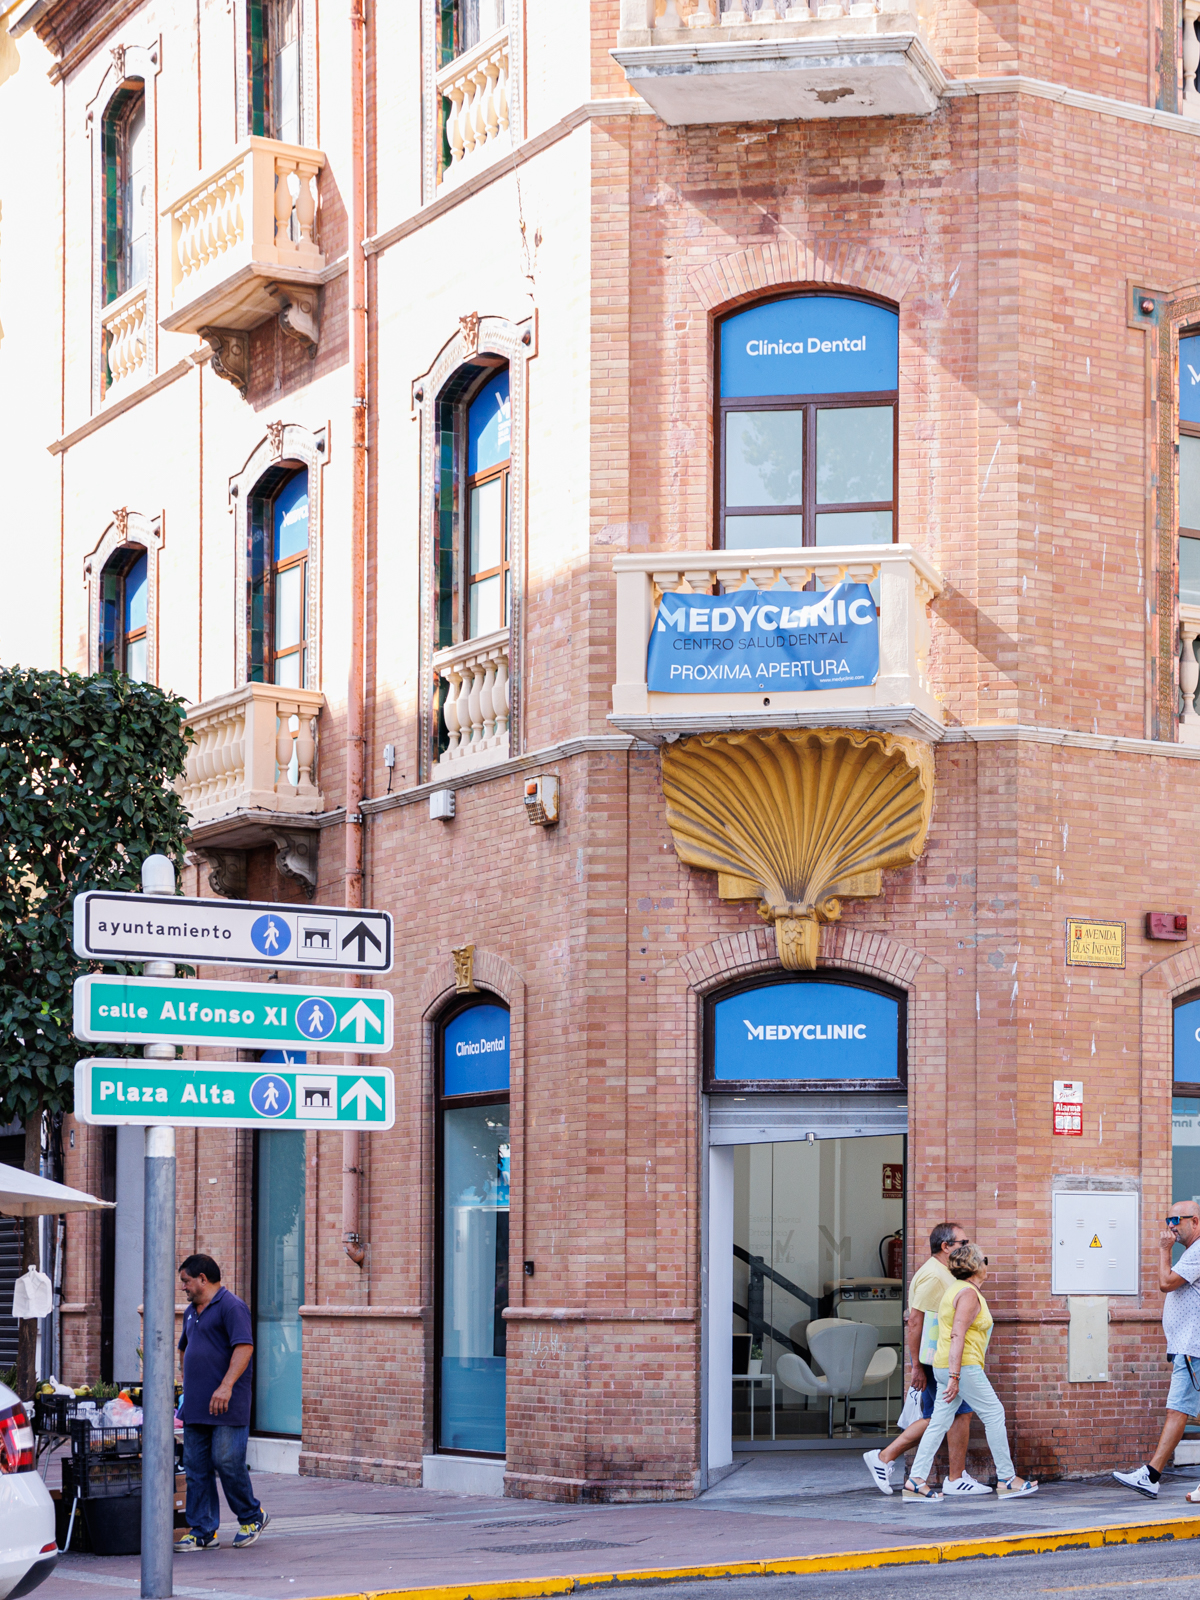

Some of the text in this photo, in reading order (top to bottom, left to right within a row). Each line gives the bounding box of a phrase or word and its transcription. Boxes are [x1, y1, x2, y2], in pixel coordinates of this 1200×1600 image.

[746, 335, 867, 356] Clínica Dental
[657, 598, 874, 633] MEDYCLINIC
[672, 631, 849, 651] CENTRO SALUD DENTAL
[669, 658, 851, 681] PROXIMA APERTURA
[819, 675, 865, 684] www.medyclinic.com
[98, 920, 232, 941] ayuntamiento
[1083, 928, 1118, 941] AVENIDA
[98, 1001, 288, 1027] calle Alfonso XI
[743, 1019, 868, 1040] MEDYCLINIC
[456, 1036, 506, 1057] Clínica Dental
[99, 1081, 236, 1105] Plaza Alta
[1055, 1103, 1081, 1112] Alarma
